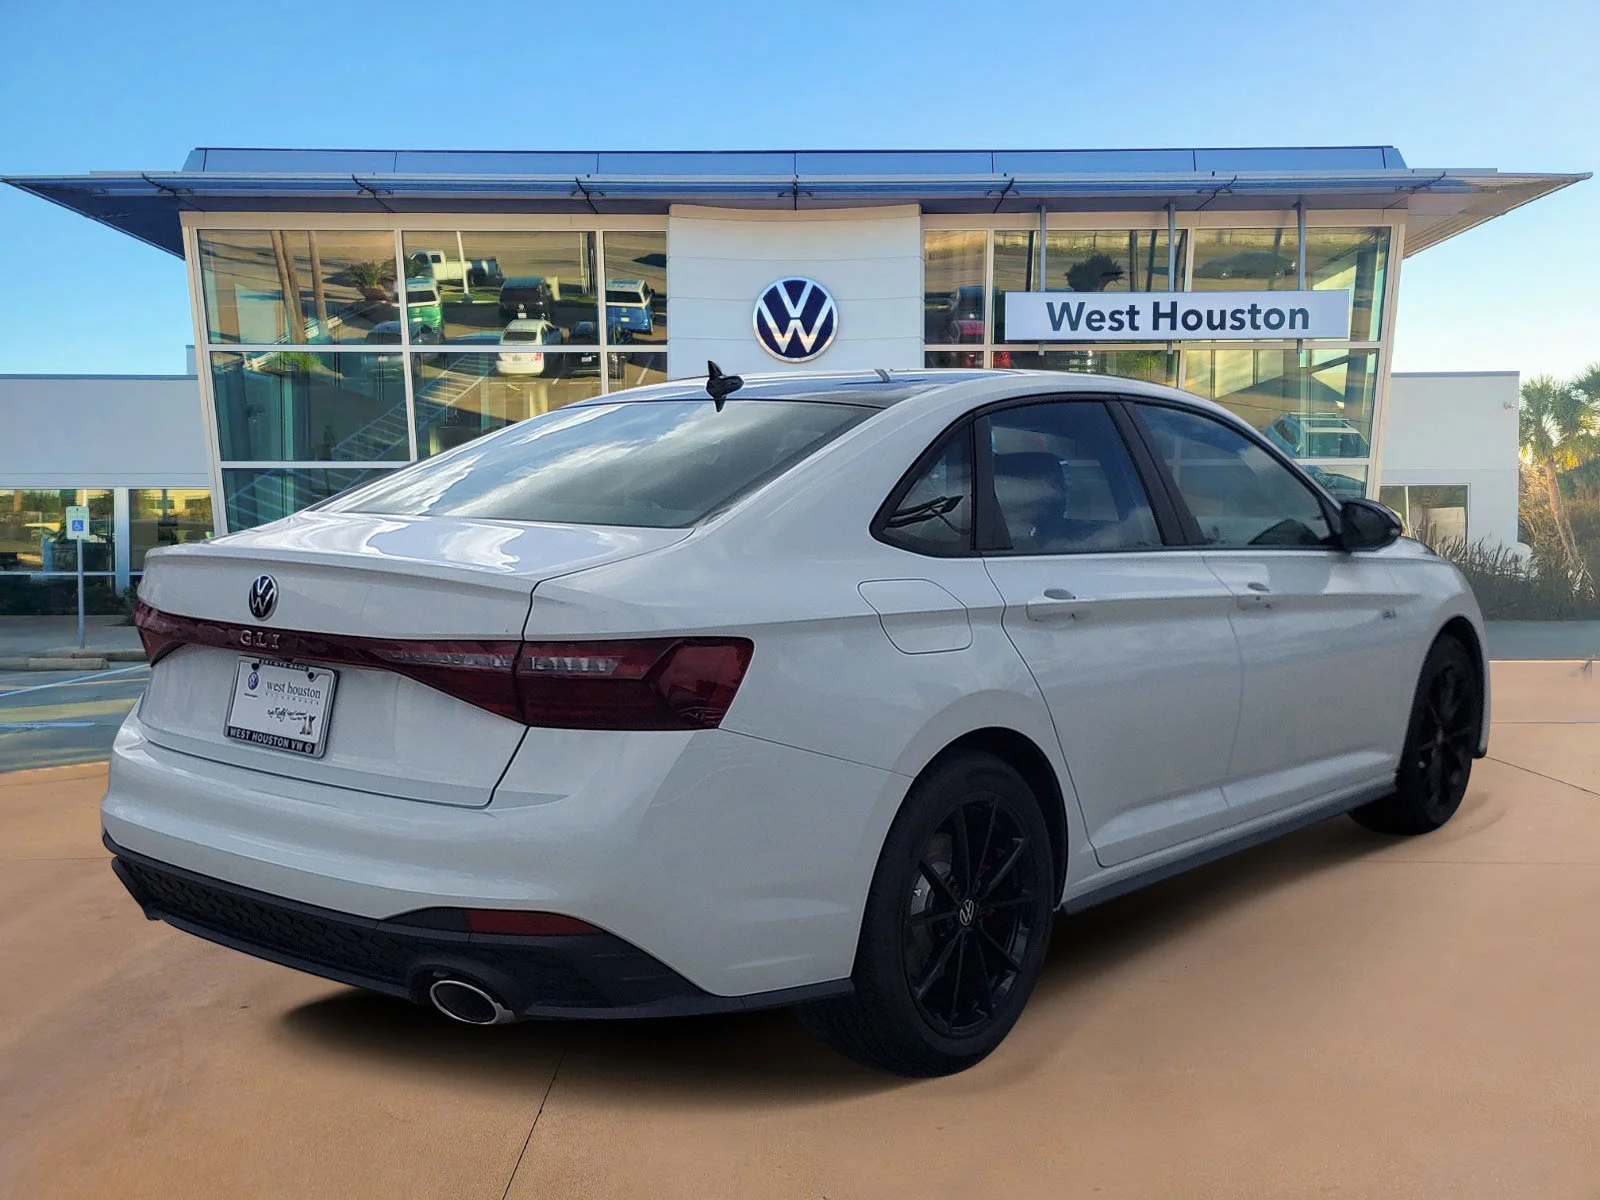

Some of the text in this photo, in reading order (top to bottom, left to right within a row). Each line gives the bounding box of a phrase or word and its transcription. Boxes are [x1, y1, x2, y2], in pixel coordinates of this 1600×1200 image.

[756, 278, 835, 358] VW
[1046, 300, 1310, 331] West Houston
[250, 574, 278, 619] VW
[240, 629, 280, 649] GLI
[266, 681, 286, 693] west
[287, 681, 321, 699] houston
[230, 727, 304, 751] WEST HOUSTON VW
